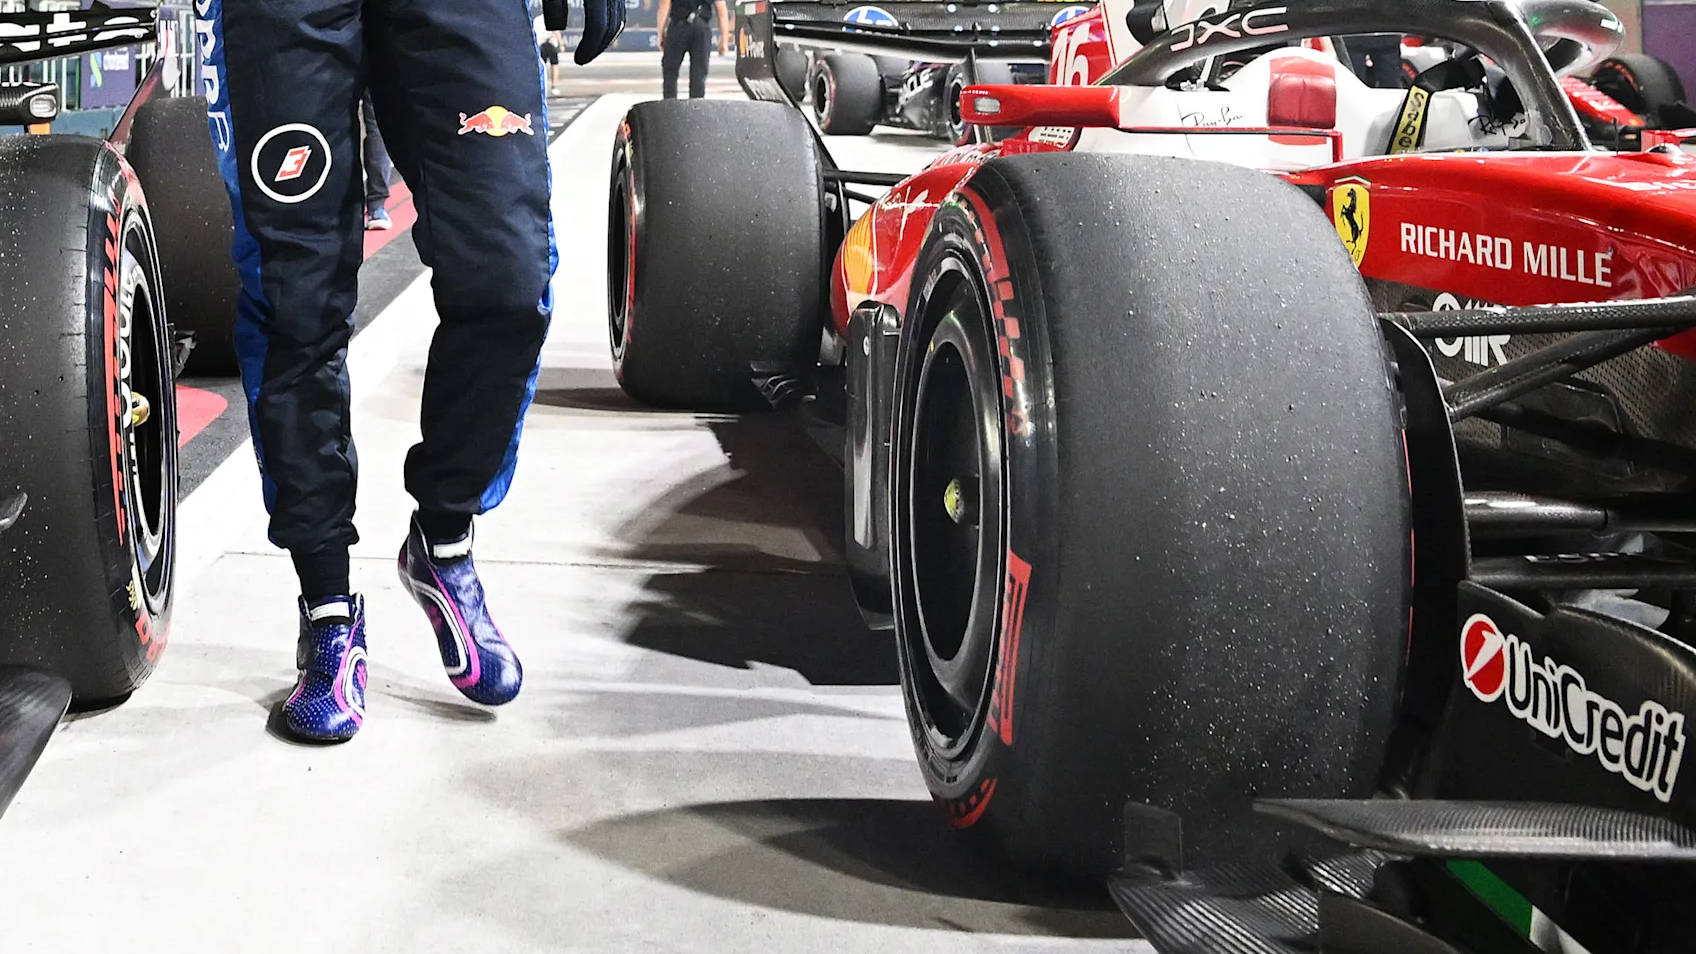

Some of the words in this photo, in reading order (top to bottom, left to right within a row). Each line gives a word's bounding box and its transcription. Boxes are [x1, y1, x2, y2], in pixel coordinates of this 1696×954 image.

[1052, 23, 1091, 87] 16
[1170, 6, 1289, 53] DXC
[1400, 222, 1512, 270] RICHARD
[1523, 242, 1613, 288] MILLE
[1506, 636, 1684, 800] UniCredit
